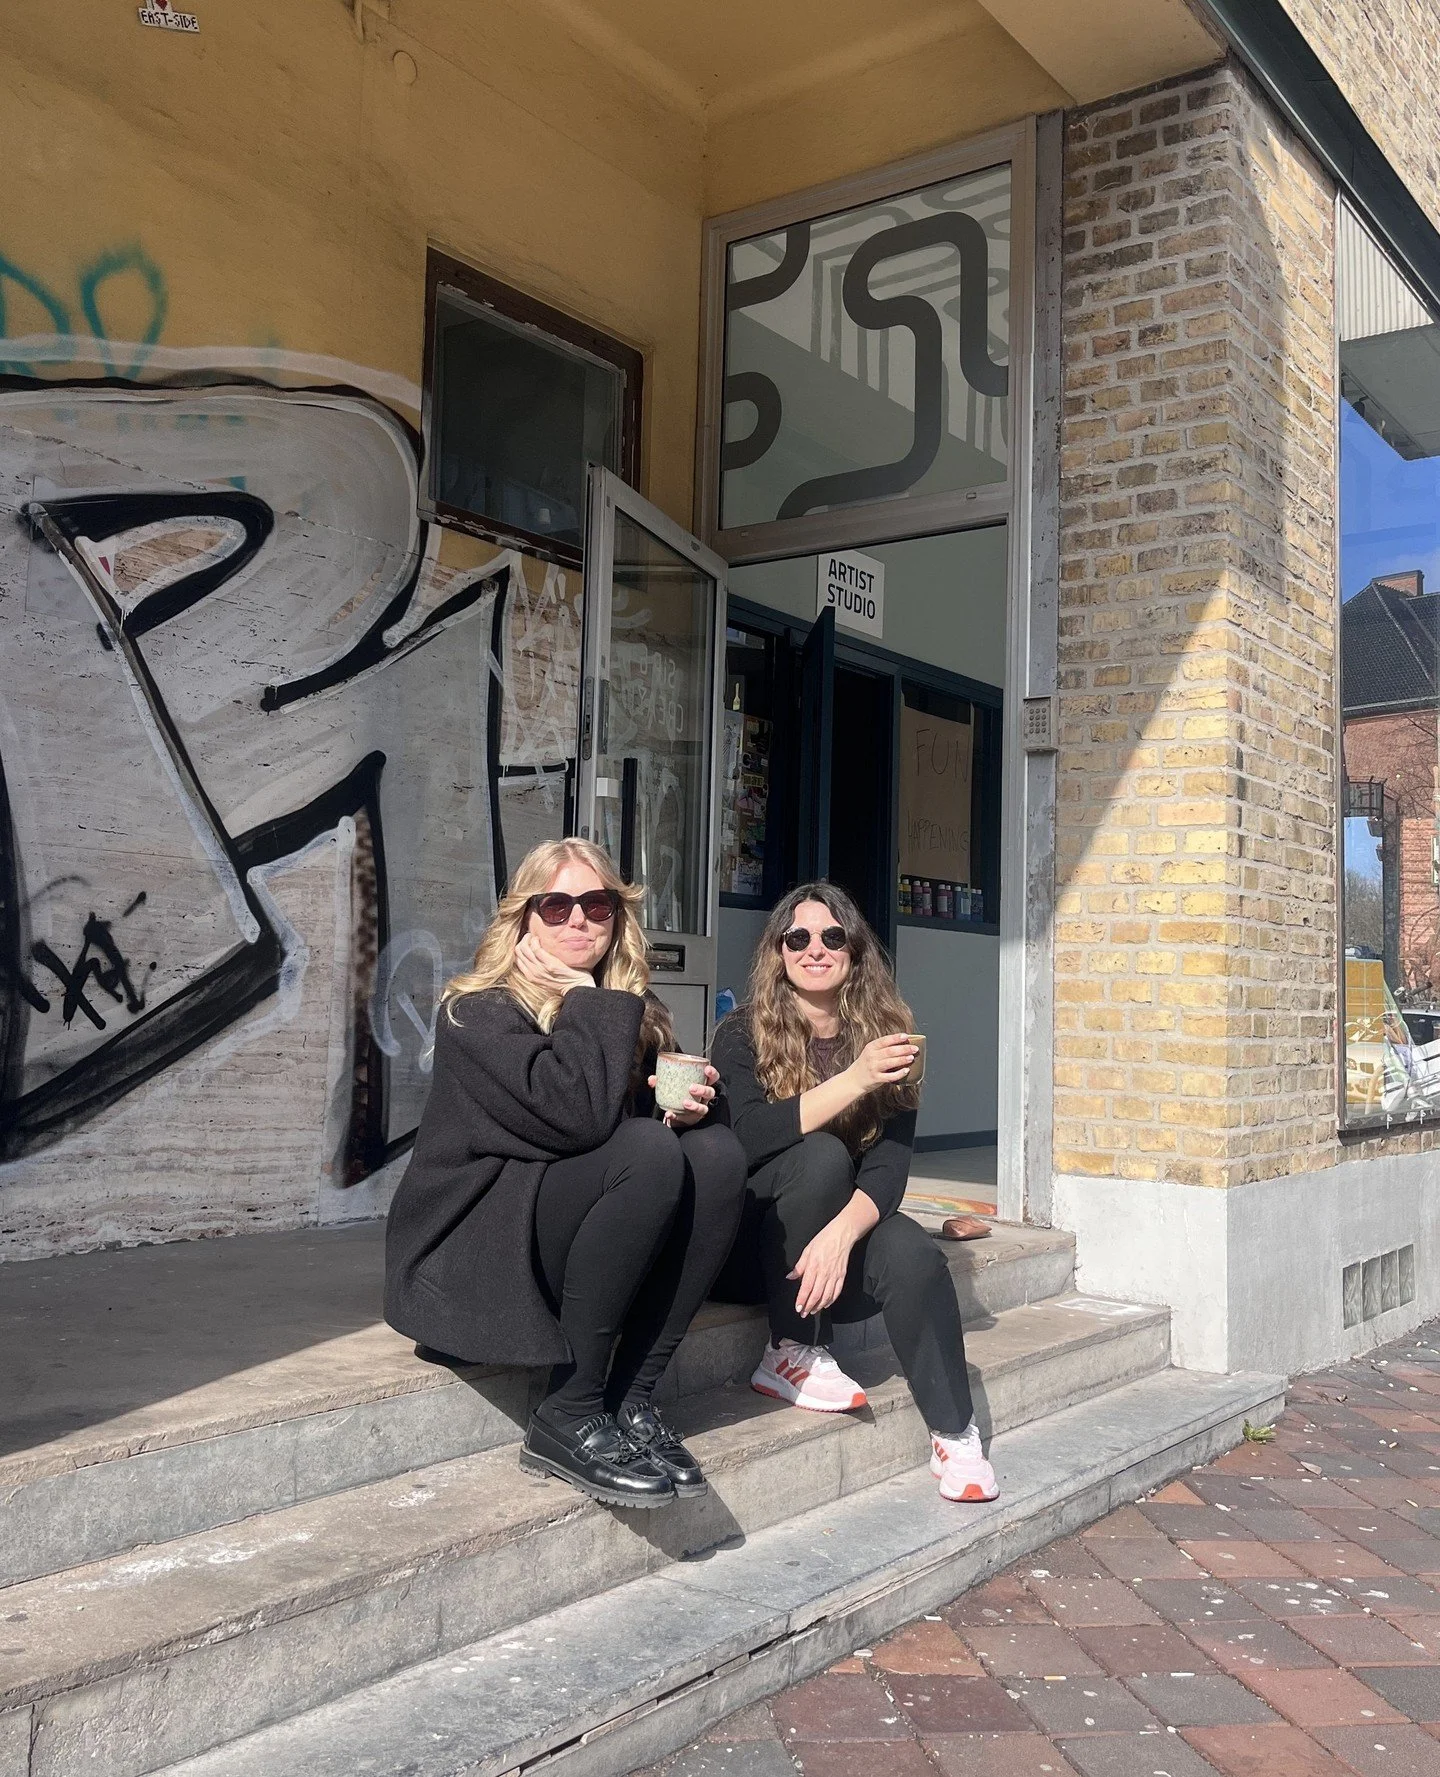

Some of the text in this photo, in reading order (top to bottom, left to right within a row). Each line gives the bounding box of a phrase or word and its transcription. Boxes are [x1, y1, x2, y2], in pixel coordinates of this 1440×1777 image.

[141, 10, 198, 29] EAST-SIDE
[828, 558, 875, 593] ARTIST
[827, 583, 876, 619] STUDIO
[916, 728, 969, 782] FUN
[907, 809, 969, 854] HAPPENING
